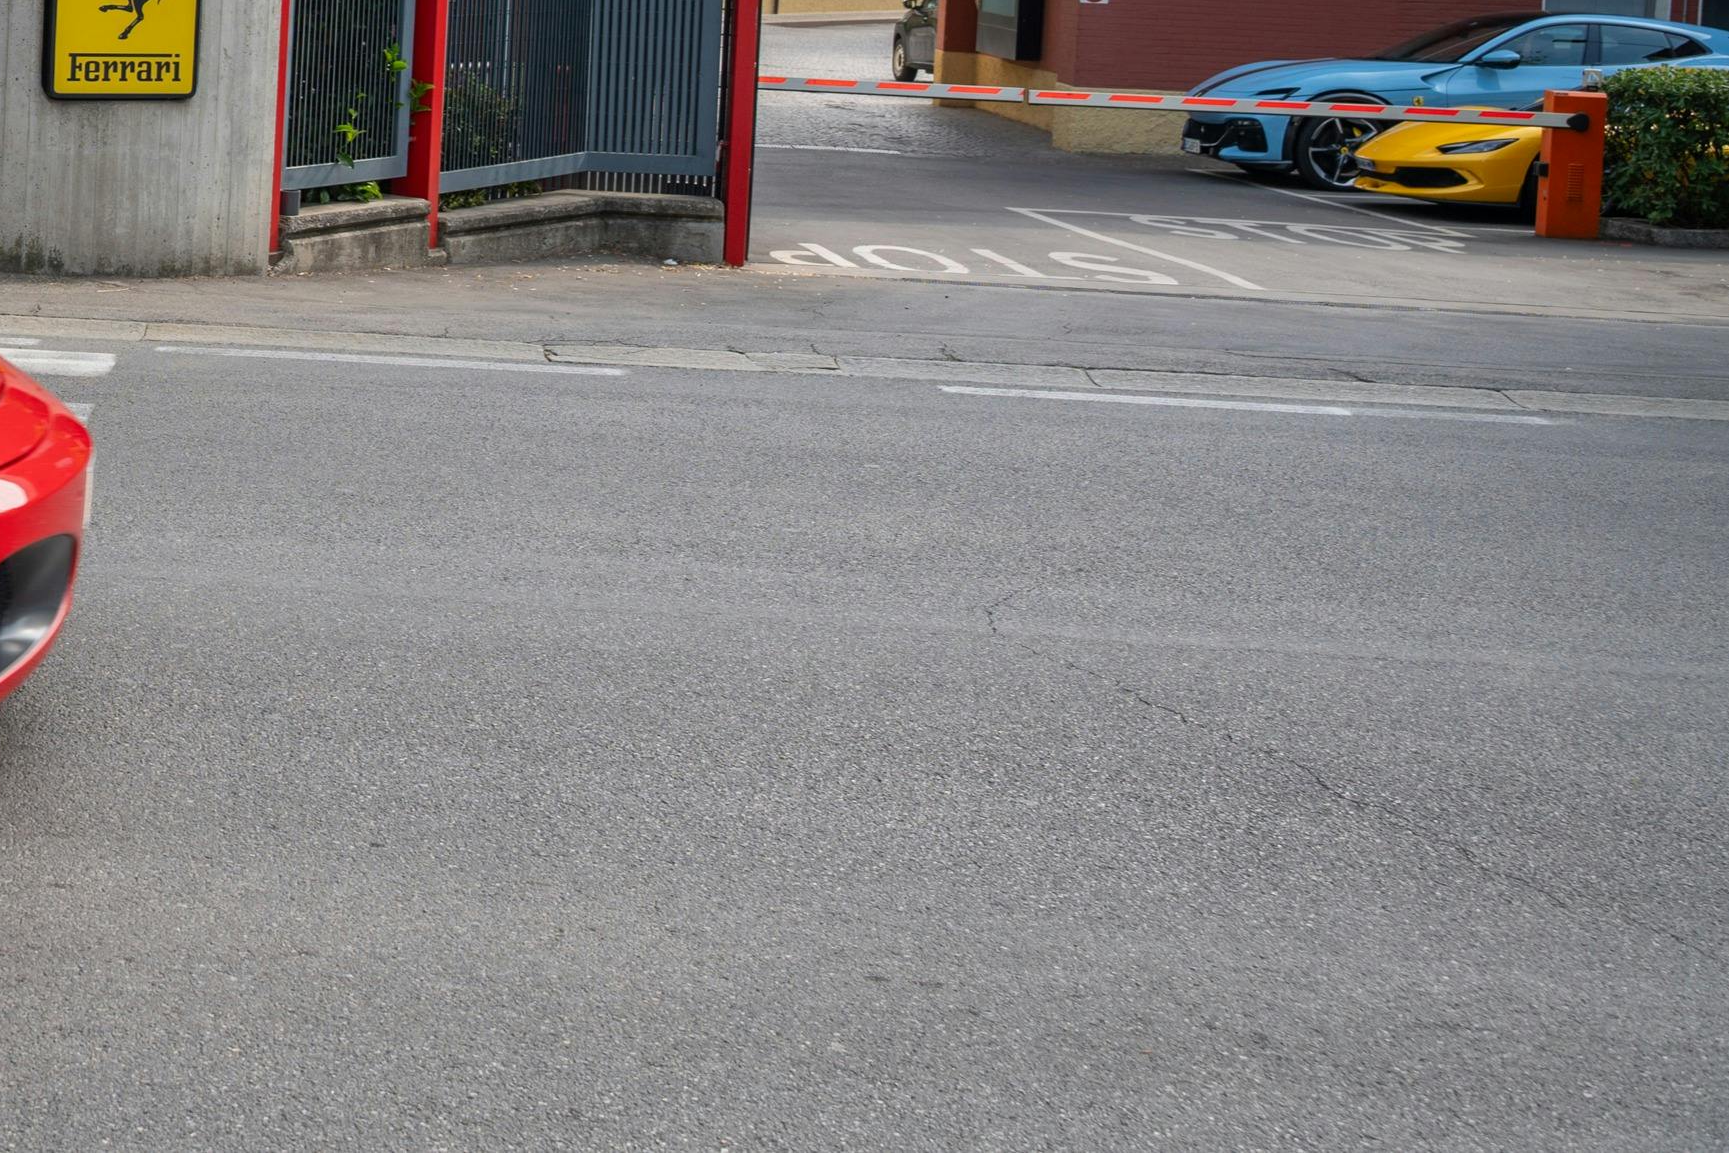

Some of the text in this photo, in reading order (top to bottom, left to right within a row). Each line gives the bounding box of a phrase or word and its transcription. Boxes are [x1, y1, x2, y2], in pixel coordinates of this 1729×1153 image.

[66, 52, 181, 82] Ferrari
[1129, 214, 1466, 254] STOP
[769, 242, 1179, 285] STOP
